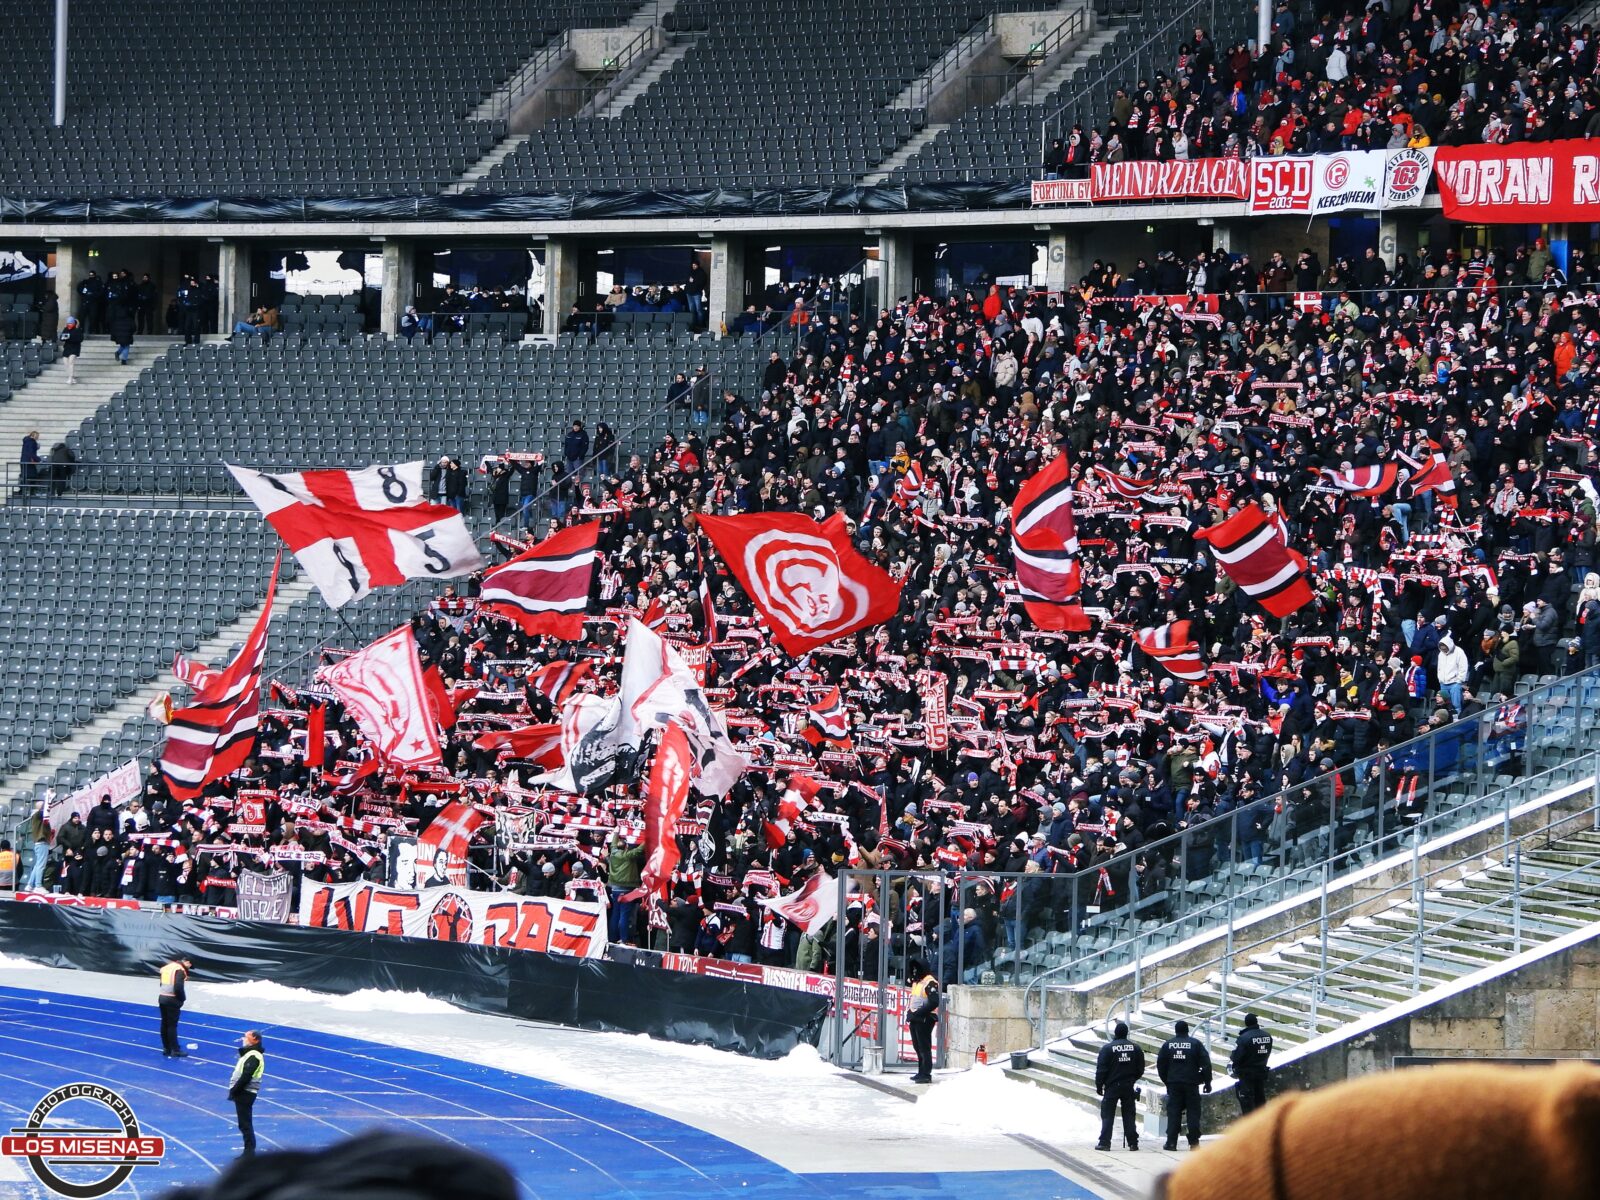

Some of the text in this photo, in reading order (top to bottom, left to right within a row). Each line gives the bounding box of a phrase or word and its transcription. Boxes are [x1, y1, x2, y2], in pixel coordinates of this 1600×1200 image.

[1029, 20, 1048, 37] 14
[1092, 157, 1251, 199] MEINERZHAGEN
[1256, 160, 1312, 198] SCD
[1392, 166, 1420, 185] 163
[1032, 181, 1091, 201] FORTUNA GV
[1316, 190, 1377, 210] KERZENHEIM
[1269, 197, 1294, 209] 2003
[1381, 235, 1395, 254] G
[714, 252, 725, 270] F
[1050, 245, 1064, 263] G
[1112, 1044, 1135, 1053] POLIZEI
[1168, 1042, 1192, 1050] POLIZEI
[1252, 1036, 1271, 1045] POLIZEI
